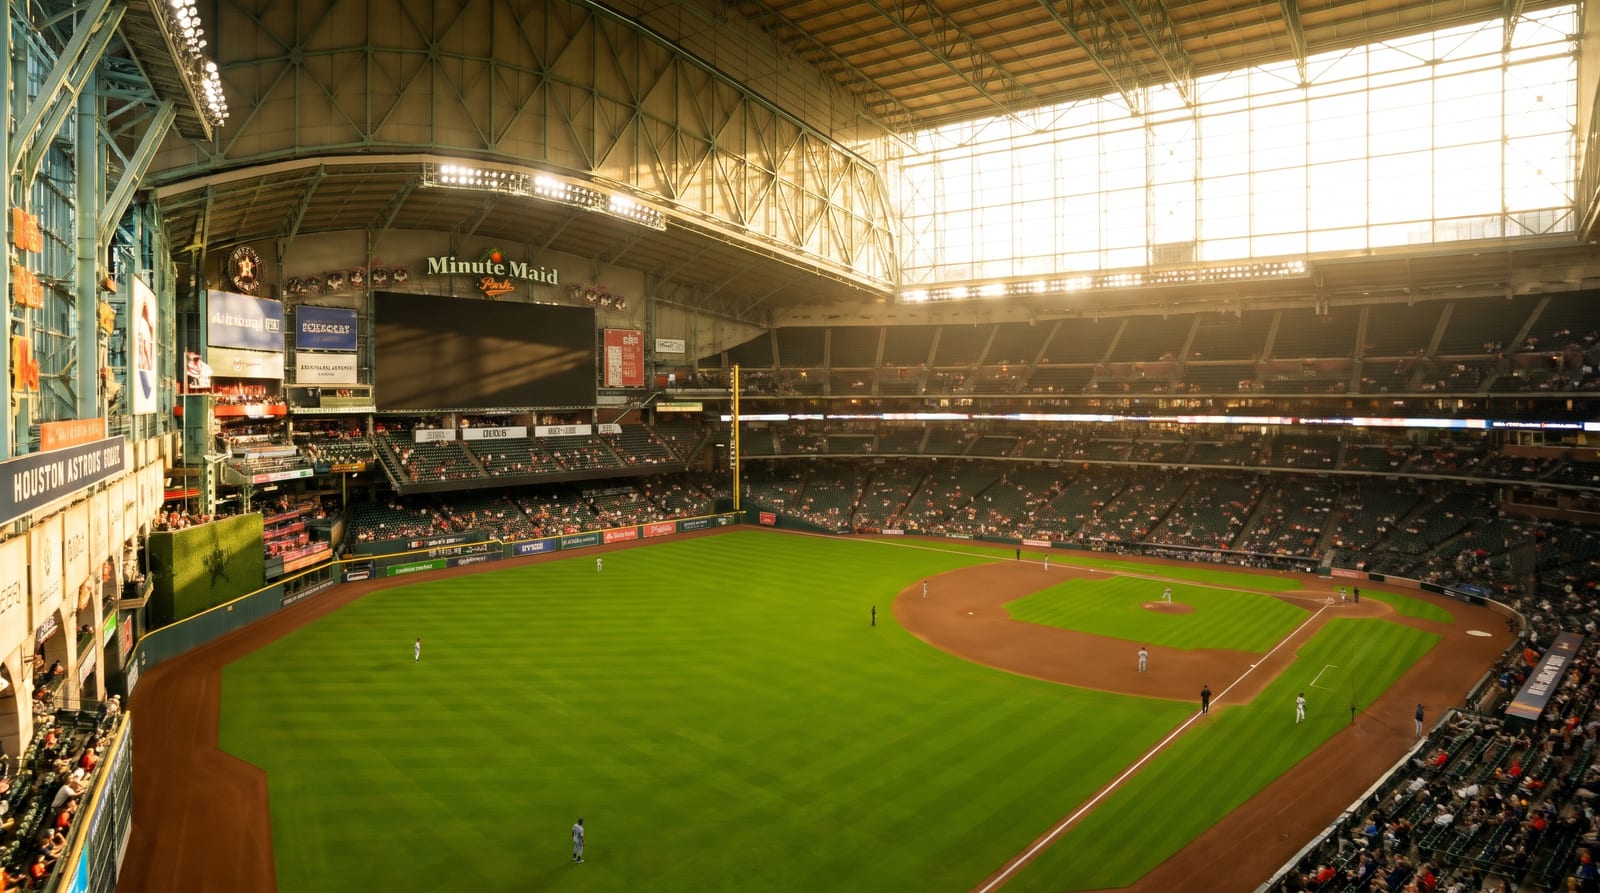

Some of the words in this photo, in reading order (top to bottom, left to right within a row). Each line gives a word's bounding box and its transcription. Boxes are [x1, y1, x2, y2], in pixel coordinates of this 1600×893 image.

[427, 256, 505, 275] Minute
[509, 261, 558, 285] Maid
[480, 277, 515, 293] Park
[14, 461, 64, 503] HOUSTON
